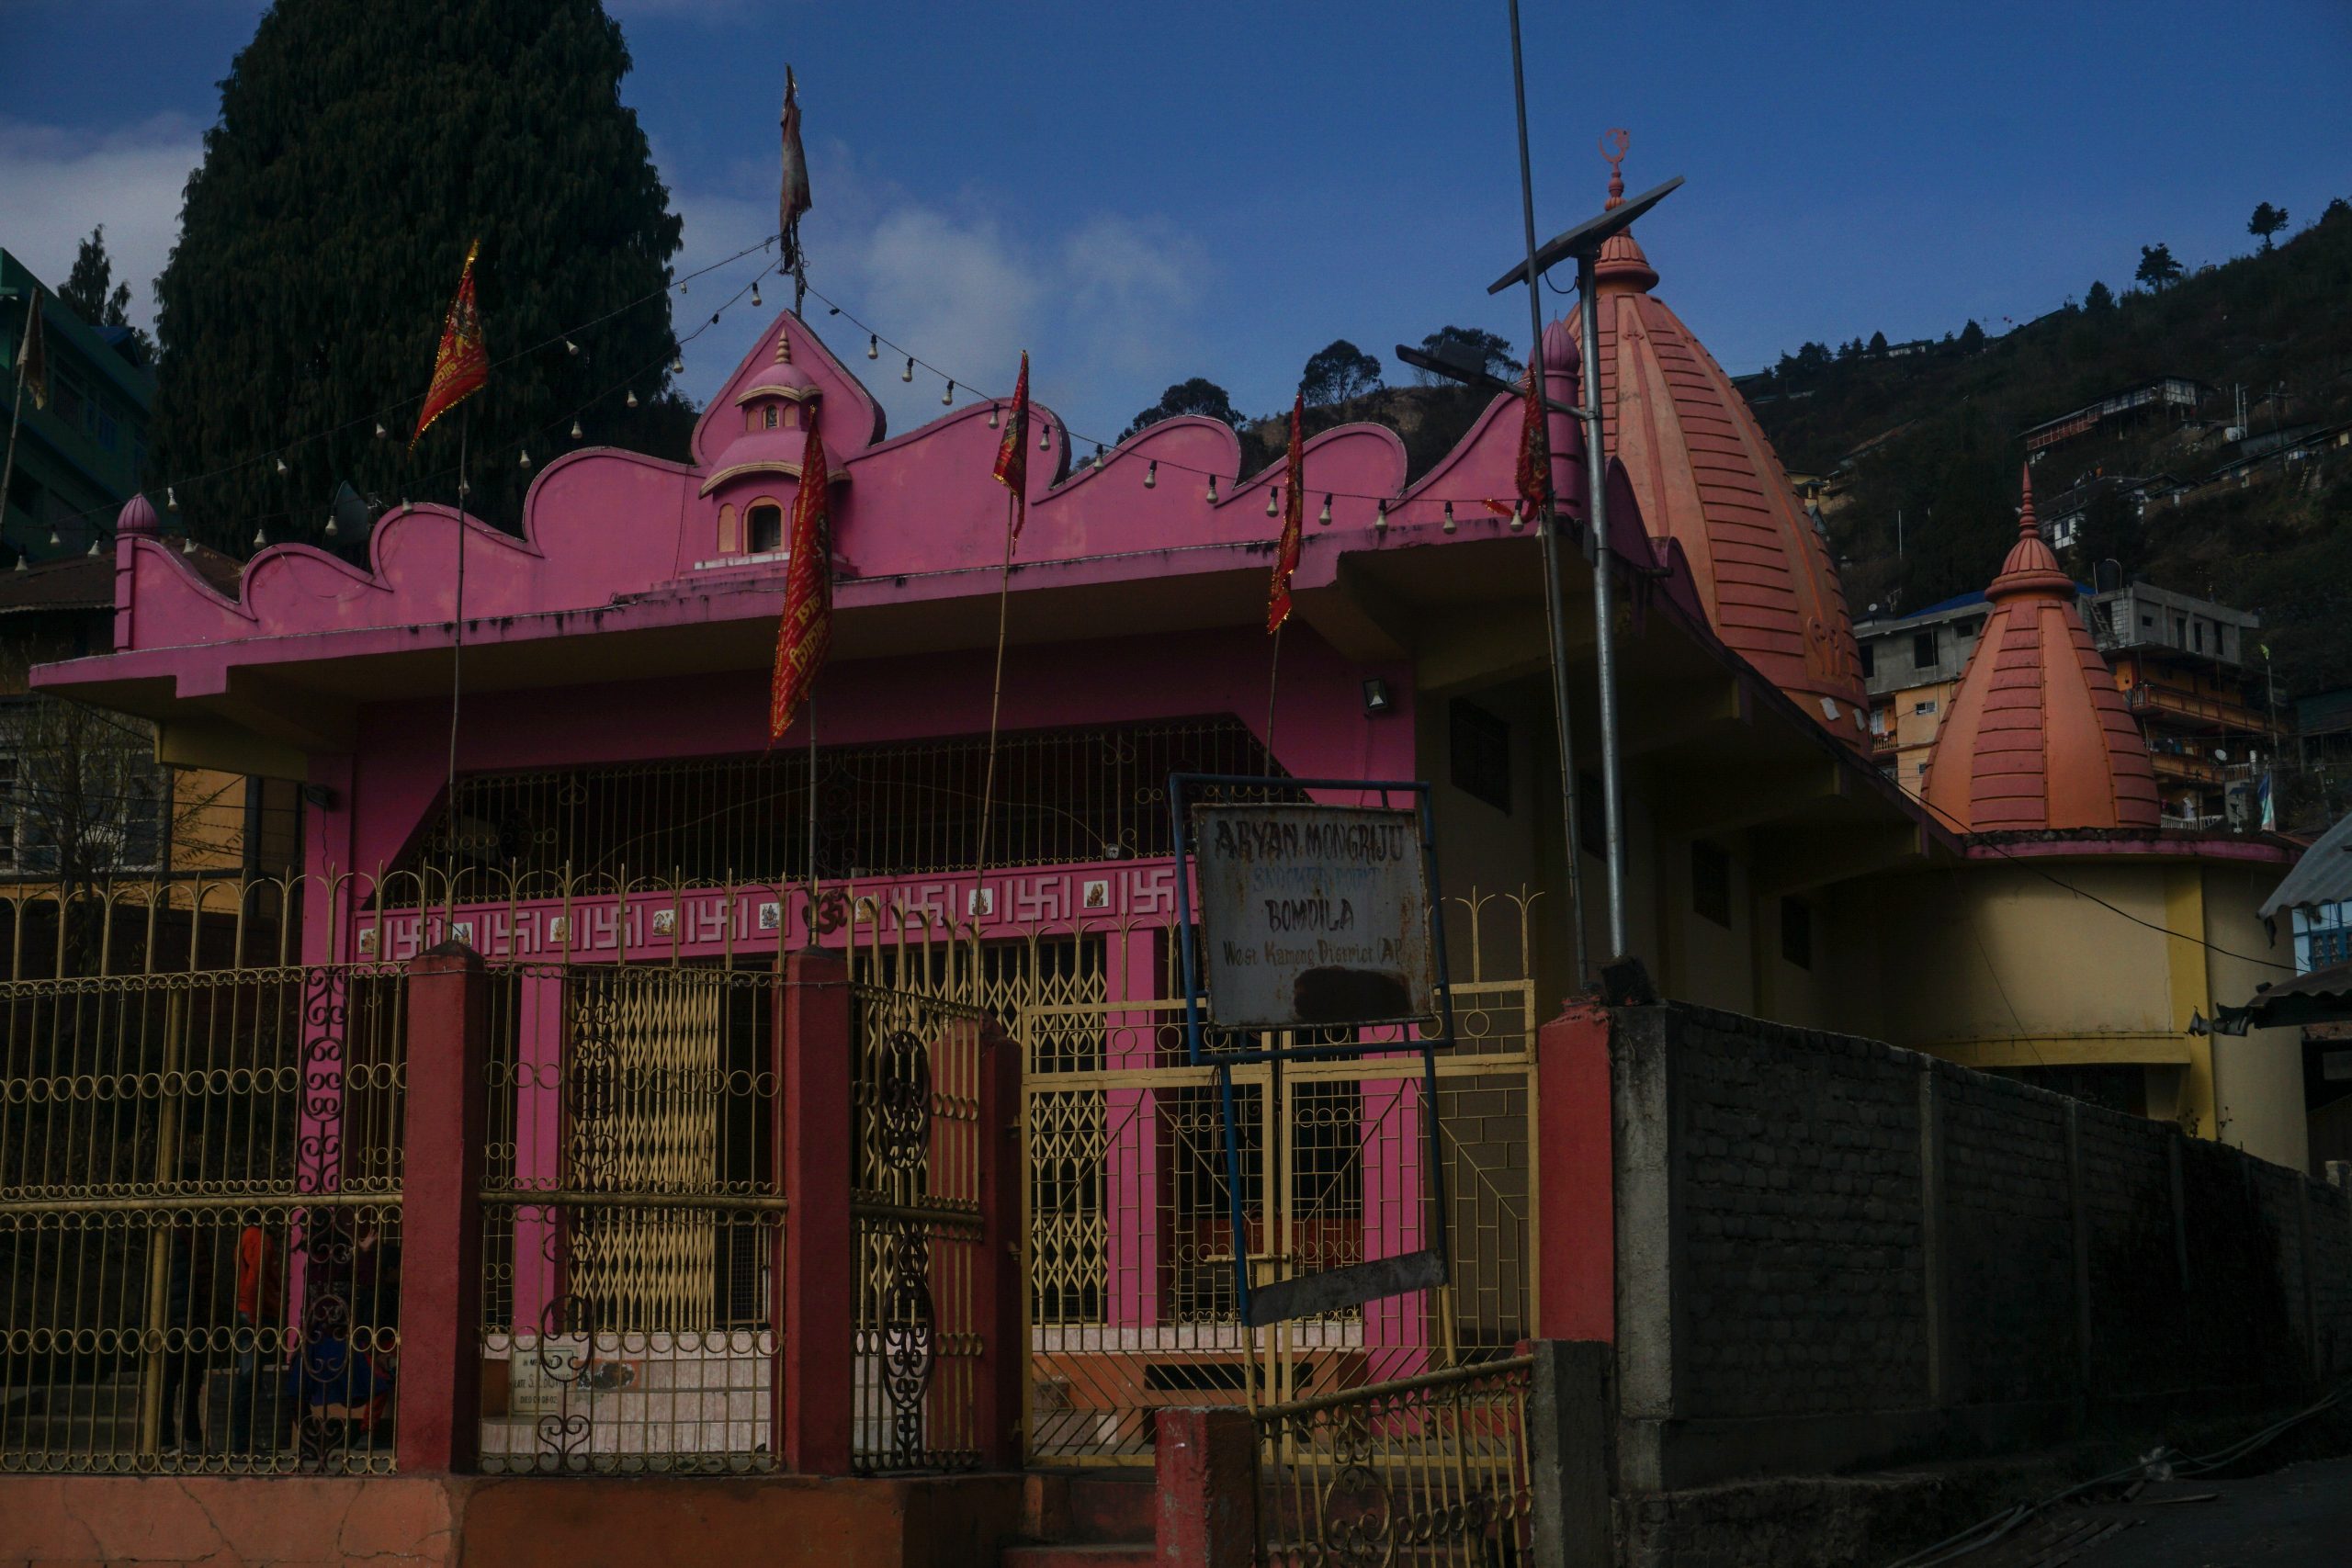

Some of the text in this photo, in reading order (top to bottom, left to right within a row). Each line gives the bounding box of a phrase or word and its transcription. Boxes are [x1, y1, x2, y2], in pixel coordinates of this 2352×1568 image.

[1215, 820, 1298, 863] ARYAN
[1265, 899, 1353, 931] BOMDILA
[1223, 940, 1258, 965] West
[1264, 940, 1315, 967] Kameng
